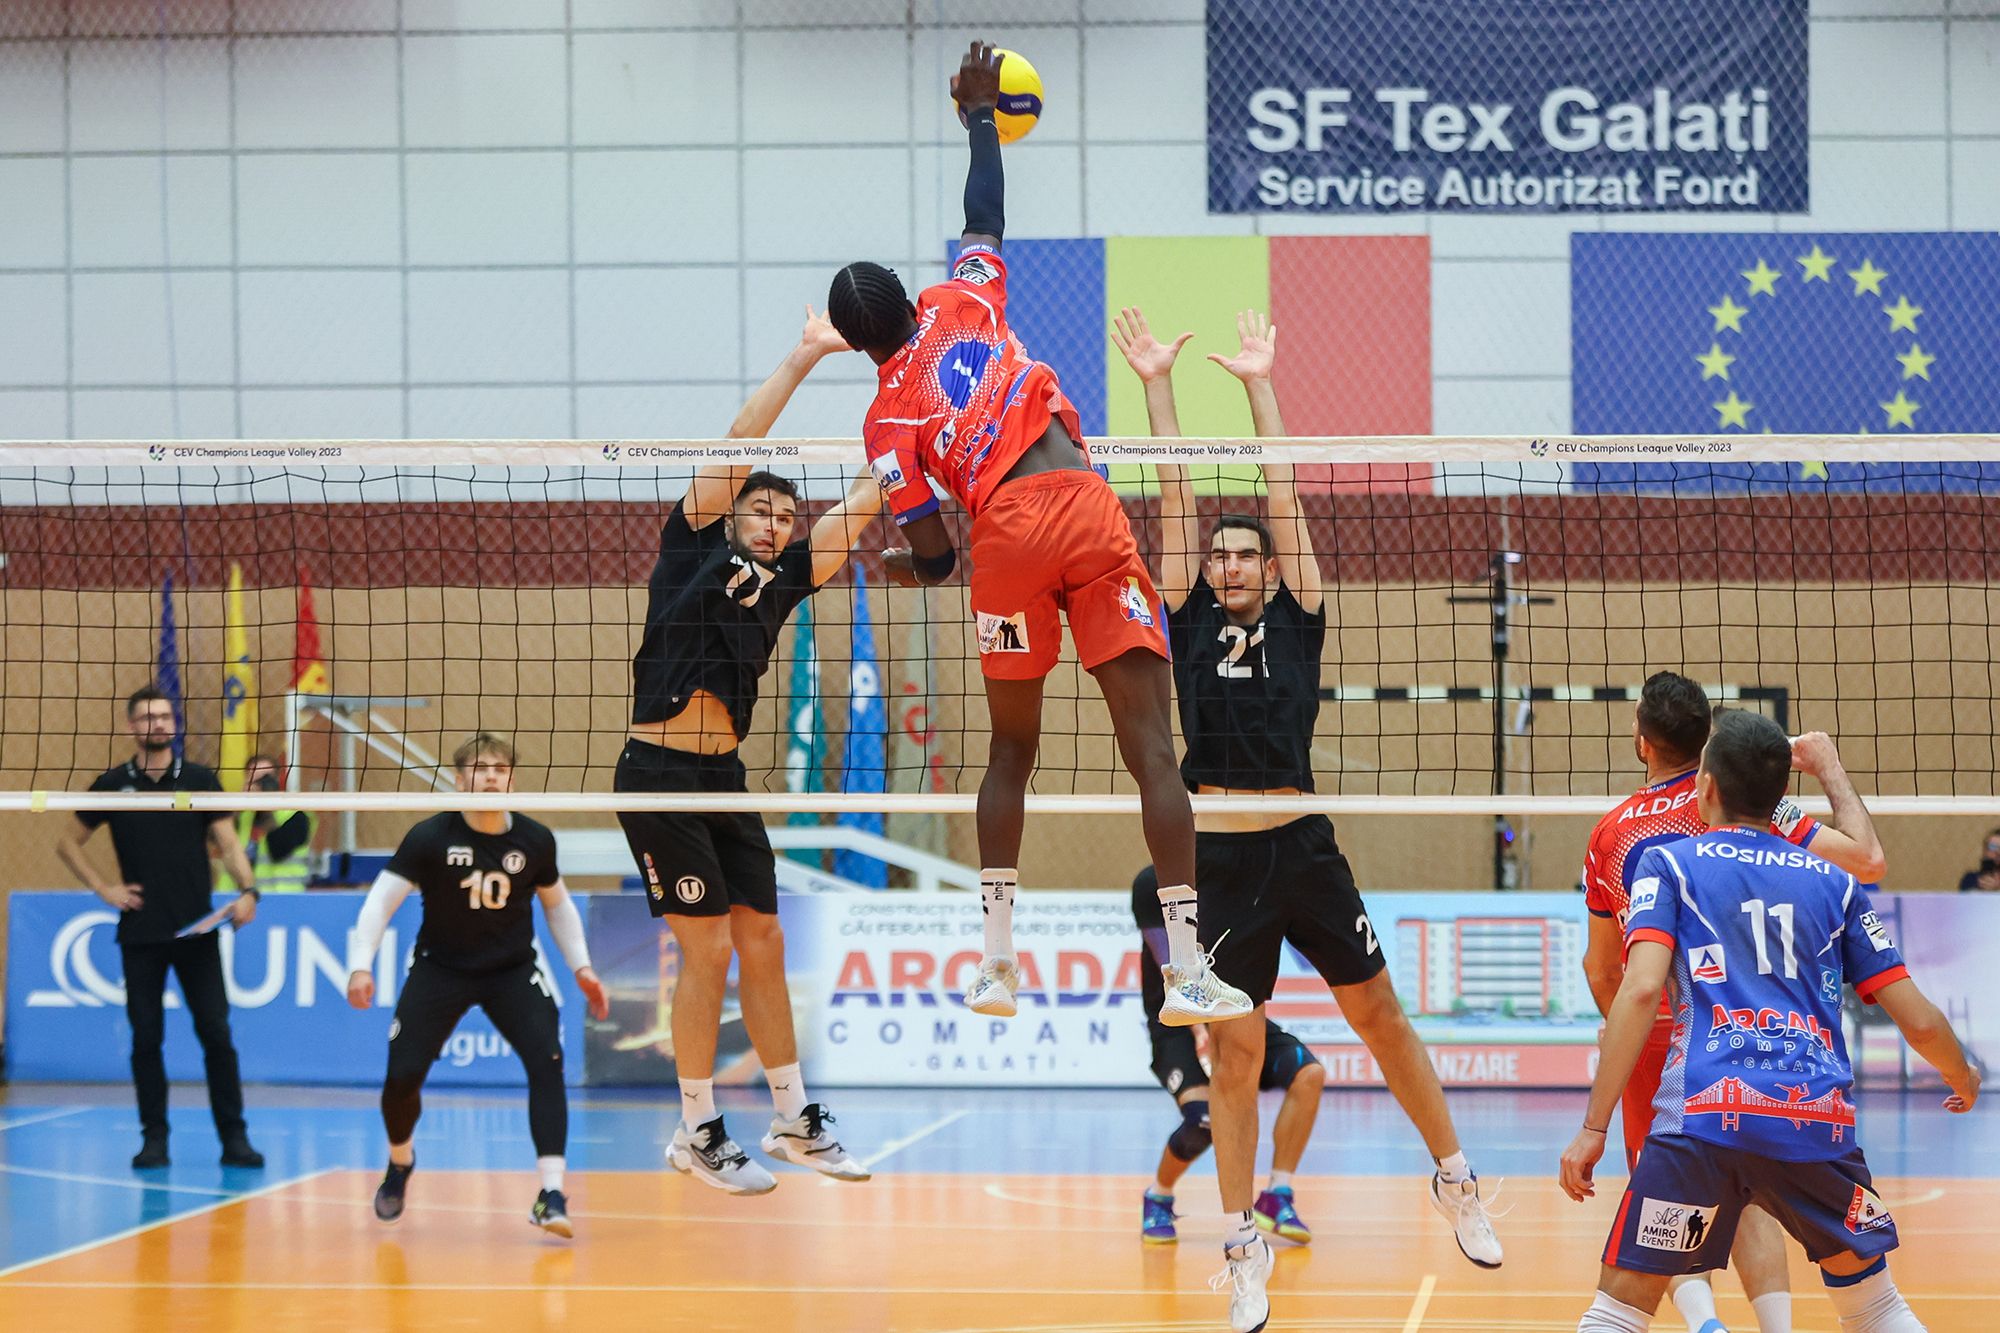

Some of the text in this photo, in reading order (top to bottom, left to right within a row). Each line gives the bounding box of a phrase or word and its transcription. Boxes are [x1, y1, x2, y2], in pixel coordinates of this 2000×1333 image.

[1246, 86, 1770, 164] SF Tex Galați
[1258, 167, 1759, 207] Service Autorizat Ford
[174, 447, 342, 459] CEV Champions League Volley 2023
[627, 446, 799, 459] CEV Champions League Volley 2023
[1089, 445, 1263, 457] CEV Champions League Volley 2023
[1557, 443, 1732, 455] CEV Champions League Volley 2023
[1696, 842, 1831, 875] KOSINSKI
[460, 870, 512, 910] 10
[1740, 898, 1799, 980] 11
[828, 1019, 1149, 1045] COMPAN
[1641, 1235, 1676, 1248] EVENTS
[1642, 1225, 1678, 1239] AMIRO
